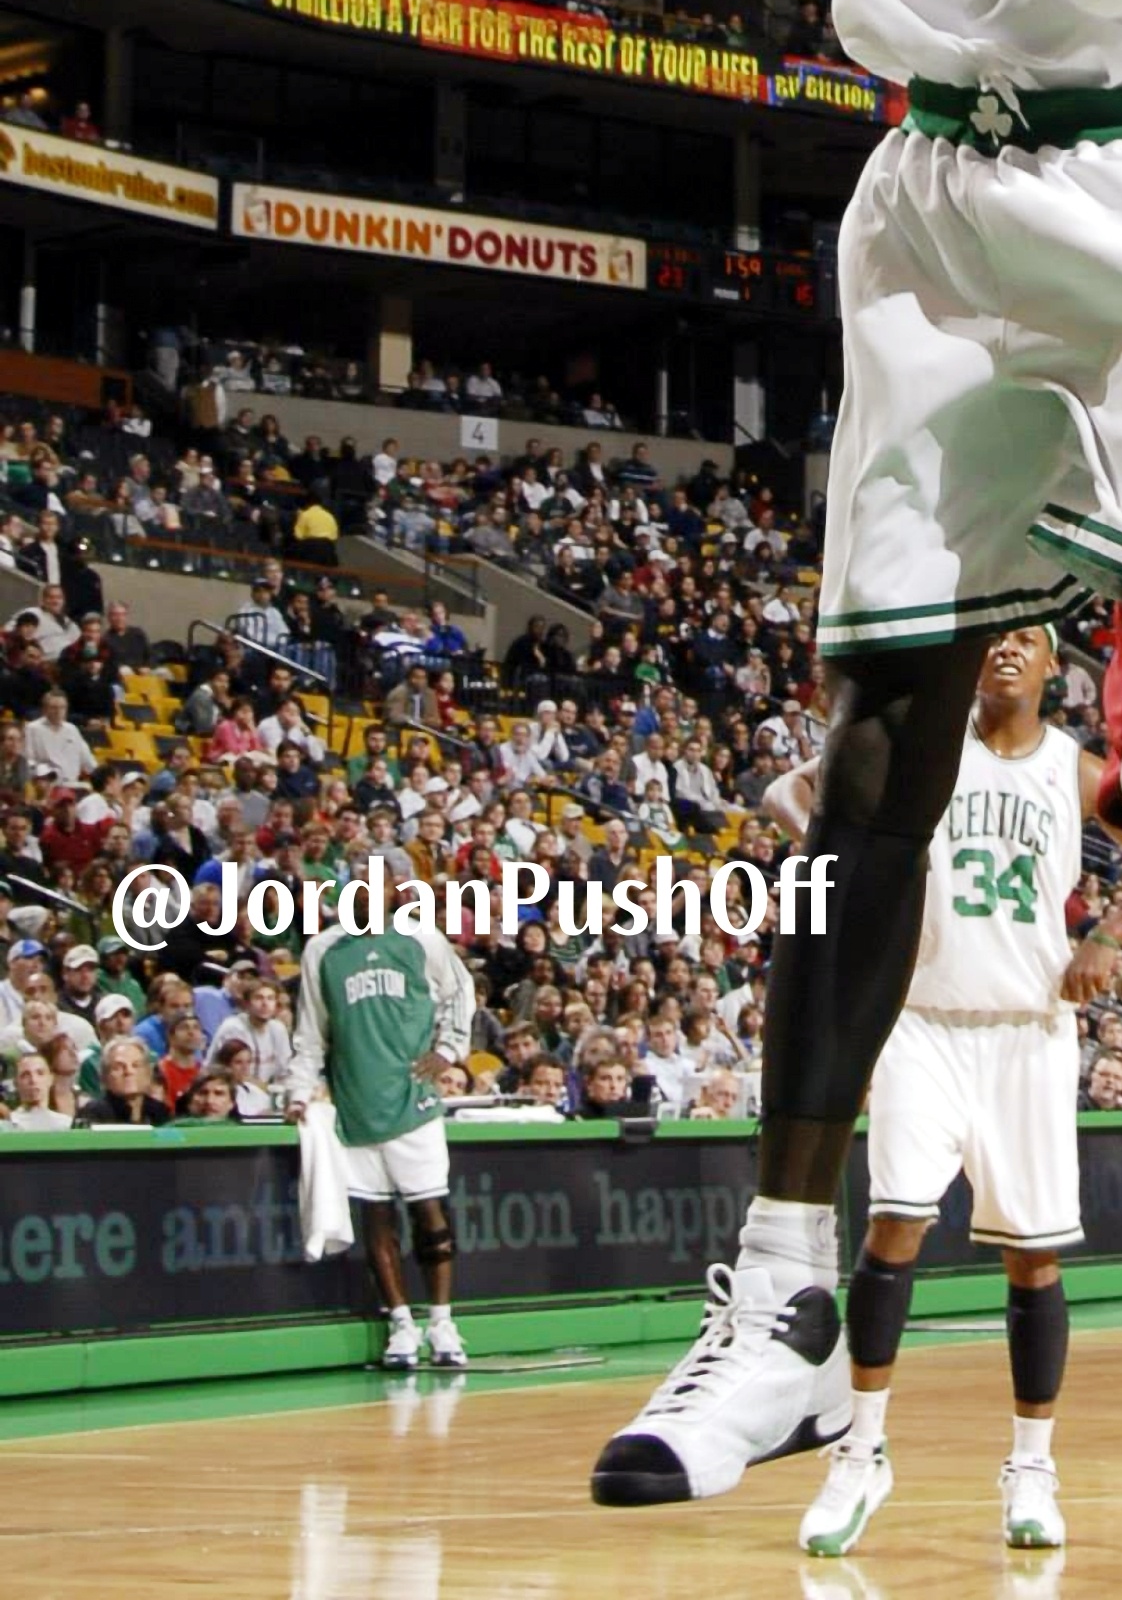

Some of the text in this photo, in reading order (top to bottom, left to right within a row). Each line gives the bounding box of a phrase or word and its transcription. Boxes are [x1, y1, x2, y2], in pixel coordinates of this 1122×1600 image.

[469, 6, 512, 55] FOR
[515, 15, 558, 61] THE
[561, 22, 616, 70] REST
[620, 33, 646, 76] OF
[651, 40, 707, 87] YOUR
[447, 226, 598, 278] DONUTS
[472, 421, 484, 444] 4
[949, 790, 1052, 856] CELTICS
[952, 847, 1038, 924] 34
[345, 968, 405, 1005] BOSTON
